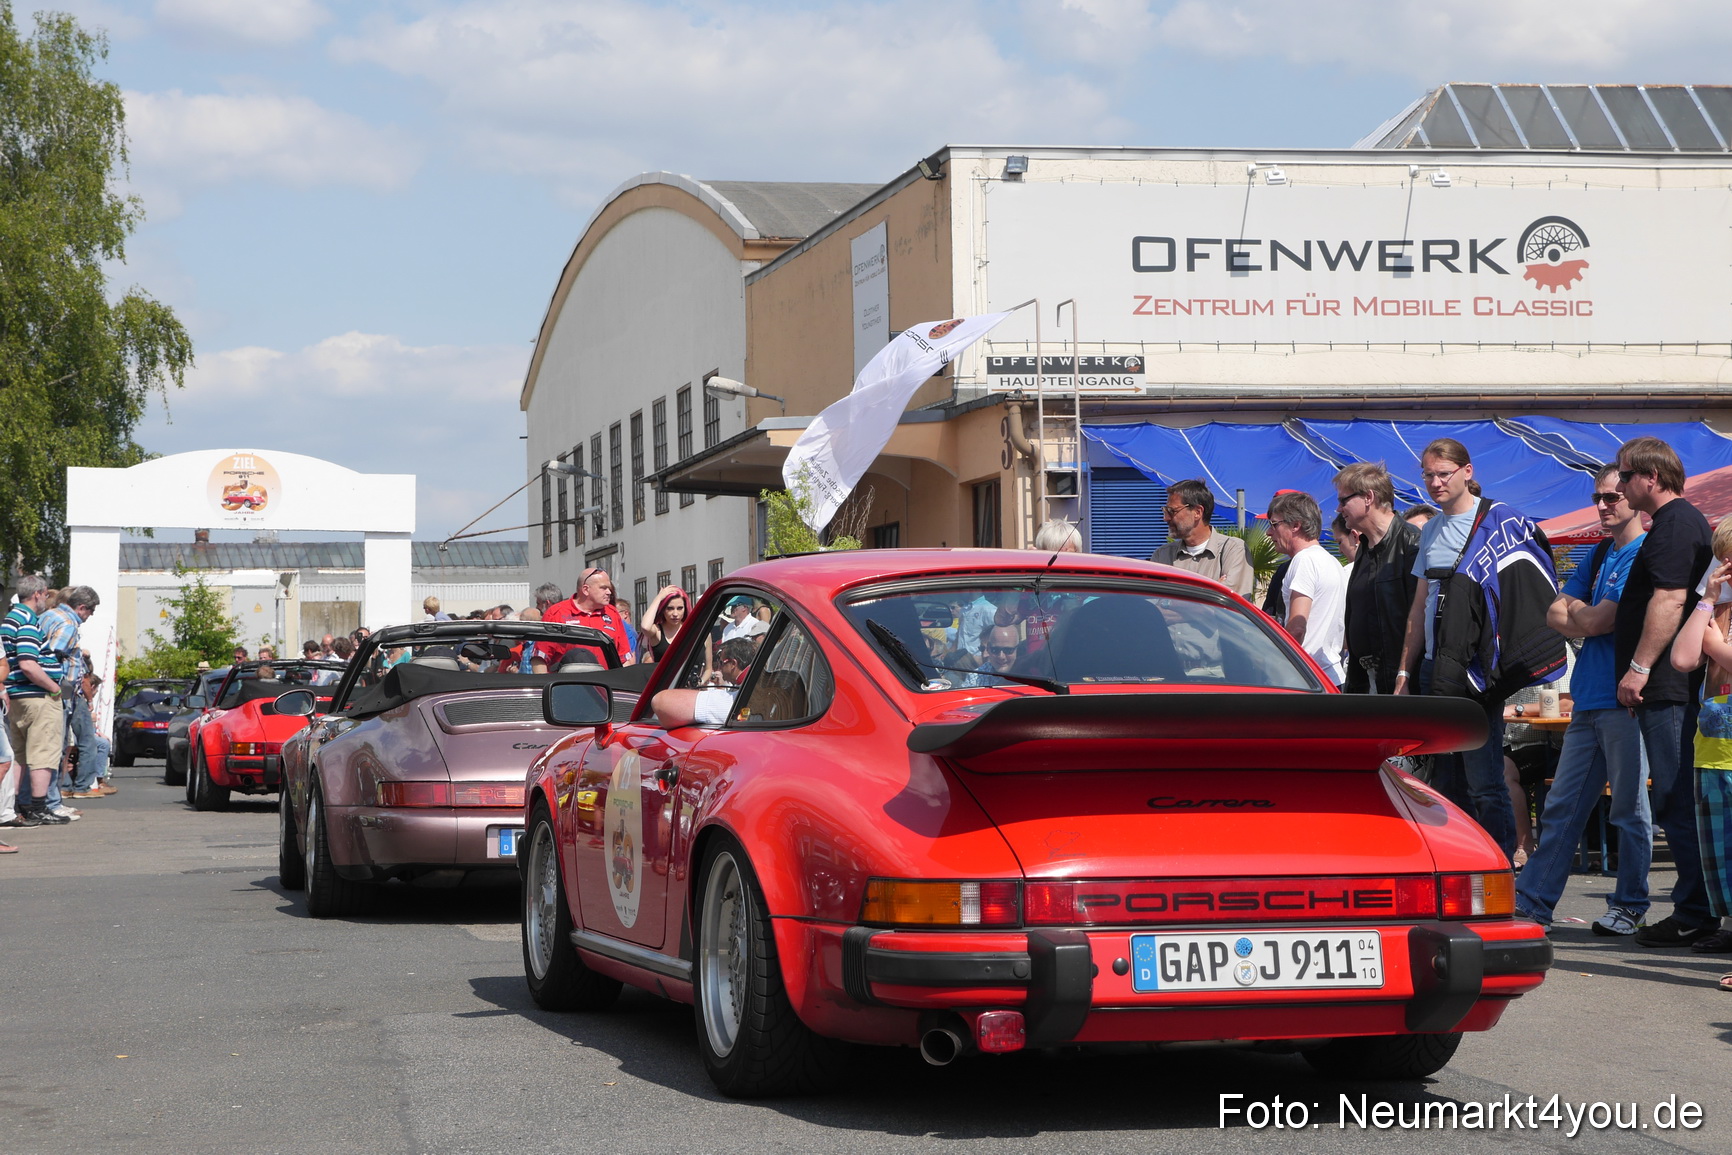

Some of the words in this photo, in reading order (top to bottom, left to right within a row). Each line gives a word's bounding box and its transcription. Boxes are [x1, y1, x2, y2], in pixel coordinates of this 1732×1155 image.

[1132, 236, 1511, 275] OFENWERK
[1132, 295, 1274, 316] ZENTRUM
[1286, 293, 1341, 316] FÜR
[1353, 296, 1461, 316] MOBILE
[1473, 296, 1593, 317] CLASSIC
[992, 357, 1122, 367] OFENWERK
[1000, 376, 1135, 387] HAUPTEINGANG
[233, 456, 257, 470] ZIEL
[1147, 796, 1278, 809] Carrera
[1077, 889, 1393, 913] PORSCHE
[1358, 939, 1375, 951] 04
[1159, 941, 1229, 982] GAP
[1260, 940, 1281, 980] J
[1291, 939, 1357, 980] 911
[1141, 968, 1151, 981] D
[1363, 967, 1377, 979] 10
